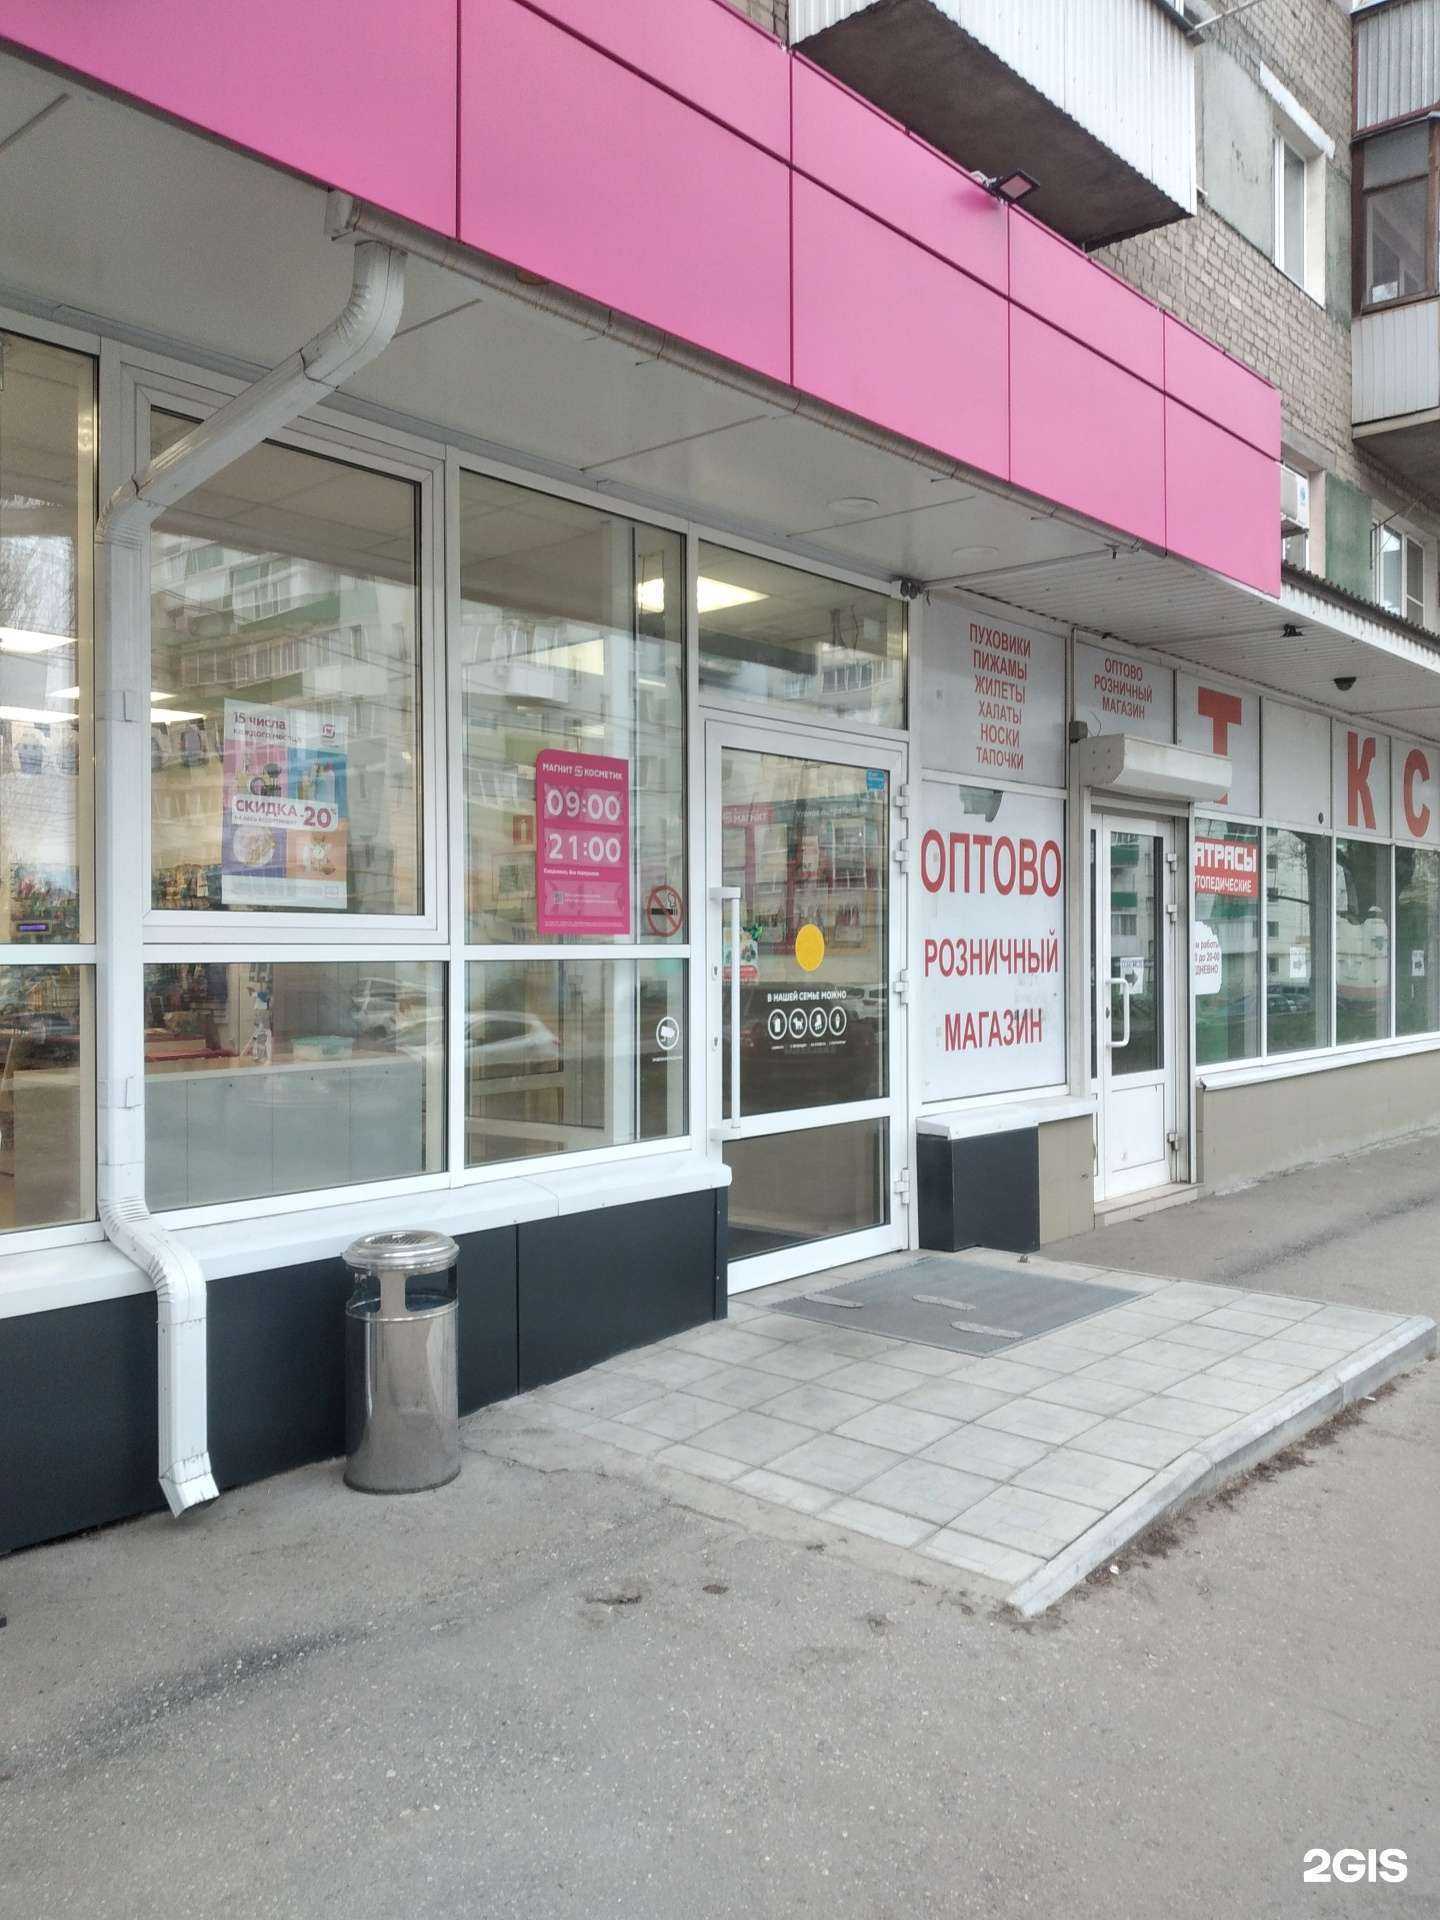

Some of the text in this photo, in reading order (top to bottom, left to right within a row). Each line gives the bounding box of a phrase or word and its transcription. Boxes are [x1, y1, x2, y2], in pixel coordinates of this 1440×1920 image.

[970, 623, 1031, 659] ПУХОВИКИ
[973, 650, 1028, 681] ПИЖАМЫ
[1104, 658, 1143, 682] ОПТОВО
[974, 675, 1026, 704] ЖИЛЕТЫ
[1094, 674, 1153, 704] РОЗНИЧНЫЙ
[978, 700, 1022, 725] ХАЛАТЫ
[1102, 696, 1145, 721] МАГАЗИН
[249, 716, 287, 730] числа
[980, 723, 1020, 749] НОСКИ
[542, 762, 573, 775] МАГНИТ
[976, 746, 1024, 770] ТАПОЧКИ
[235, 799, 298, 817] СКИДКА
[545, 788, 621, 821] 09:00
[548, 833, 622, 864] 21:00
[1194, 841, 1257, 873] АТРАСЫ
[920, 829, 1062, 898] ОПТОВО
[1194, 874, 1252, 893] ТОПЕДИЧЕСКИЕ
[924, 928, 1059, 978] РОЗНИЧНЫЙ
[767, 992, 773, 1003] В
[774, 988, 798, 1002] НАШЕЙ
[821, 987, 847, 1000] МОЖНО
[945, 1007, 1043, 1052] МАГАЗИН
